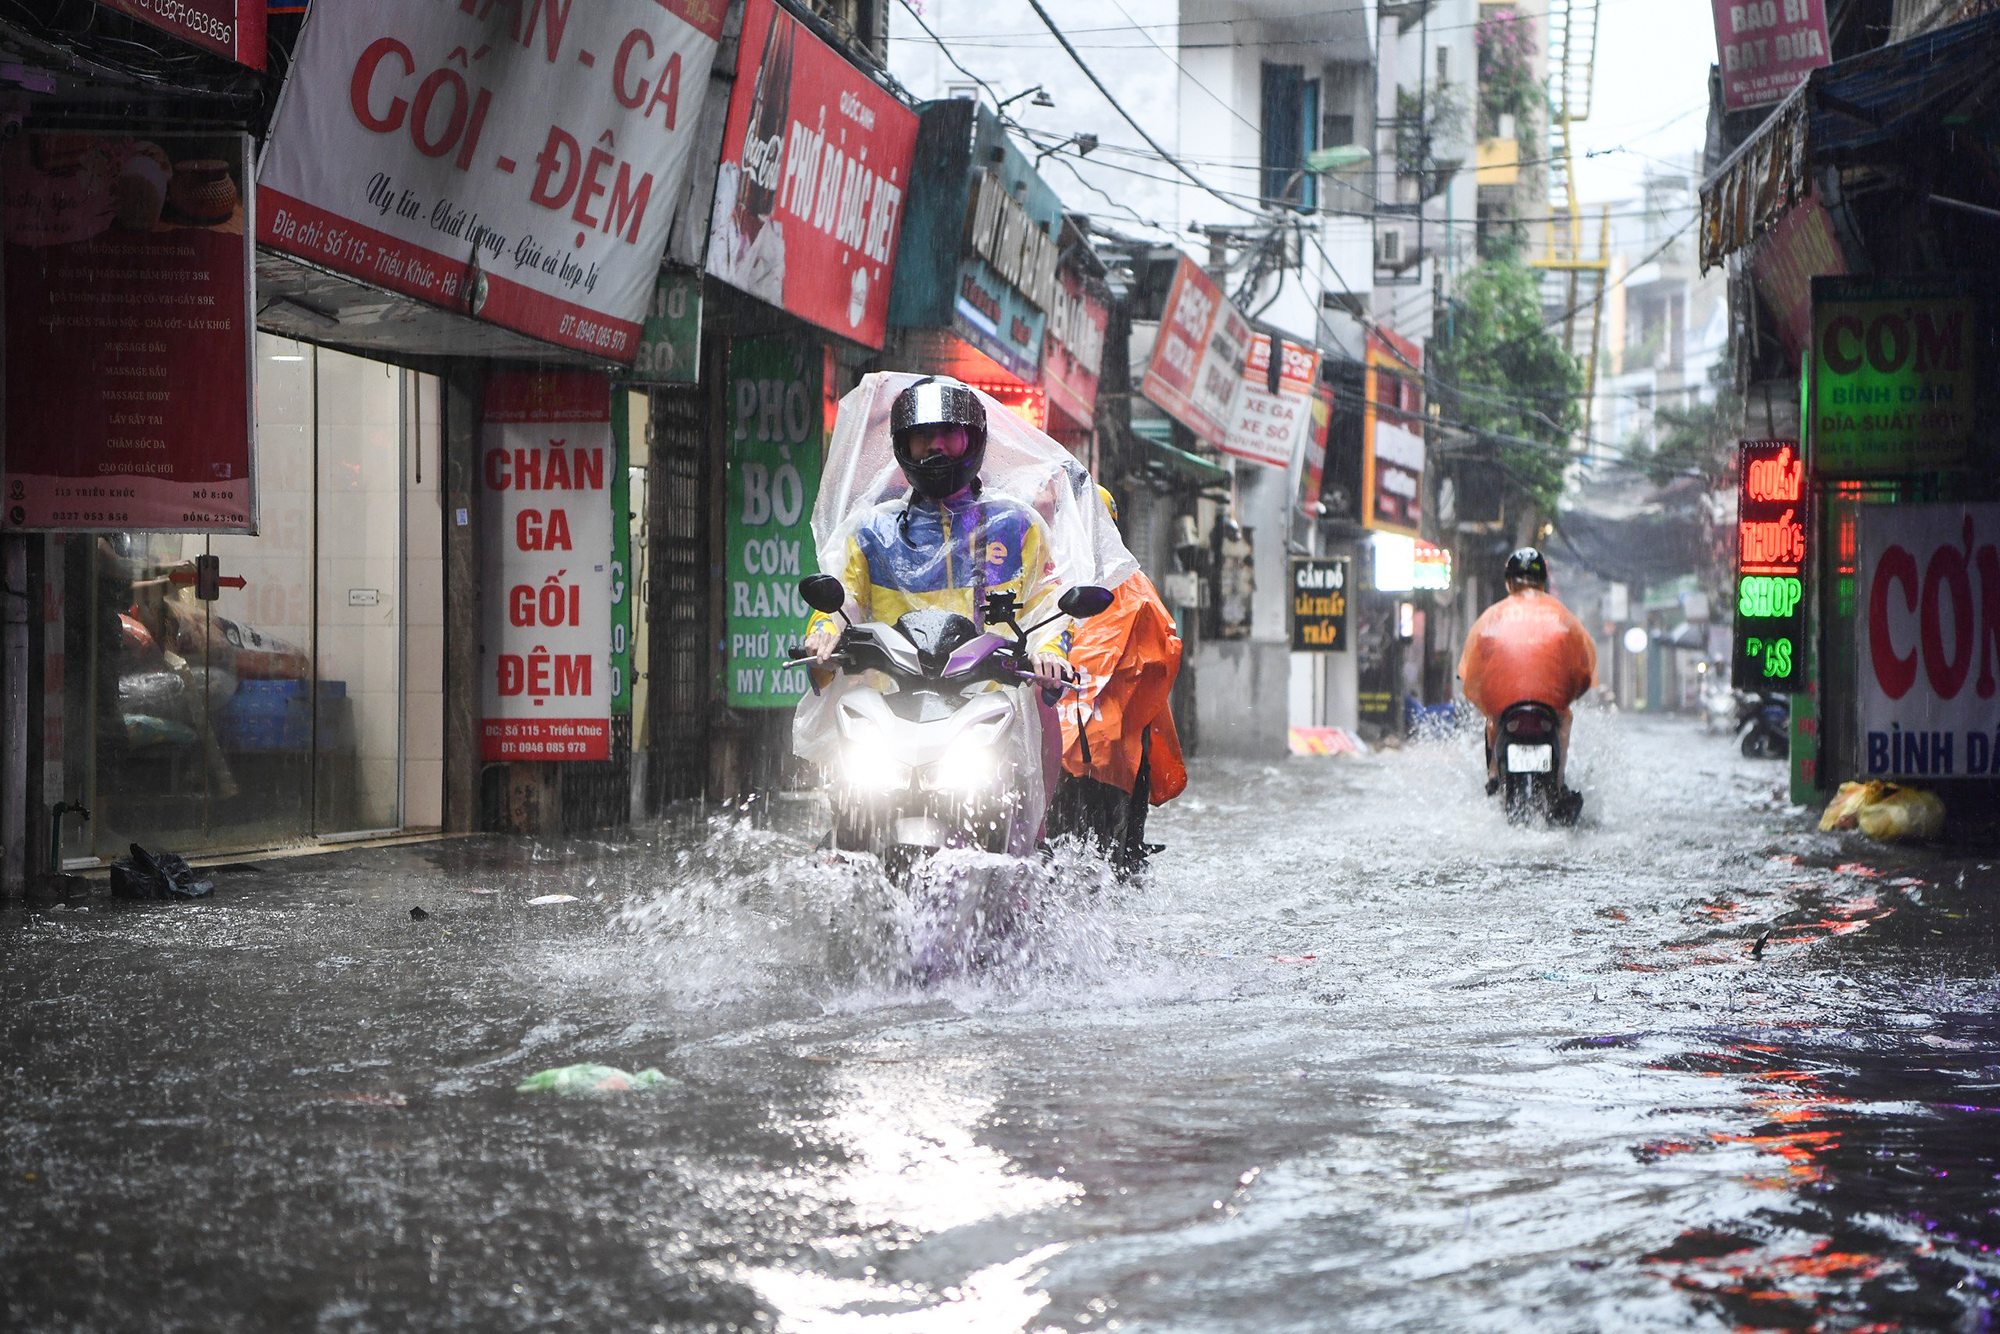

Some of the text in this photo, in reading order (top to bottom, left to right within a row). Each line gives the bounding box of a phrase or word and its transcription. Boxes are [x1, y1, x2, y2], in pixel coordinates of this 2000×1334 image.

[1729, 1, 1777, 34] BAO
[530, 125, 653, 249] ĐỆM
[780, 104, 826, 222] PHỞ
[814, 129, 844, 234] BÒ
[836, 145, 873, 265] ĐẶC
[864, 166, 902, 281] BIỆT
[272, 209, 297, 242] Địa
[297, 220, 323, 249] chỉ:
[324, 229, 347, 256] Số
[344, 236, 367, 264] 115
[374, 247, 403, 277] Triều
[404, 258, 435, 288] Khúc
[440, 271, 458, 297] Hà
[430, 198, 467, 238] Chất
[514, 234, 543, 271] Giá
[559, 252, 583, 289] hợp
[192, 271, 210, 281] 39K
[197, 295, 215, 306] 89K
[104, 342, 147, 353] MASSAGE
[575, 320, 597, 343] 0946
[595, 326, 612, 348] 085
[610, 330, 627, 351] 978
[1822, 305, 1964, 376] CƠM
[104, 366, 147, 377] MASSAGE
[101, 390, 170, 401] MASSAGE BODY
[735, 353, 811, 443] PHỞ
[1245, 397, 1294, 420] XE GA
[1832, 381, 1890, 405] BÌNH
[148, 415, 163, 425] TAI
[1241, 418, 1262, 434] XE
[135, 437, 152, 449] SÓC
[153, 439, 166, 449] DA
[485, 439, 604, 491] CHĂN
[109, 487, 136, 497] KHÚC
[211, 490, 234, 500] 8:00
[741, 444, 804, 527] BÒ
[53, 511, 243, 523] 0327 053 856 ĐÓNG 23:00
[516, 508, 573, 552] GA
[1741, 509, 1804, 562] THUỐC
[743, 533, 800, 576] CƠM
[508, 568, 579, 628] GỐI
[733, 581, 810, 618] RANG
[1740, 577, 1802, 617] SHOP
[733, 626, 769, 658] PHỞ
[496, 645, 592, 706] ĐỆM
[505, 723, 519, 736] Số
[521, 725, 539, 736] 115
[549, 723, 575, 736] Triều
[577, 724, 602, 736] Khúc
[519, 742, 544, 753] 0946
[546, 742, 566, 753] 085
[567, 742, 587, 753] 978
[1867, 722, 1954, 775] BÌNH
